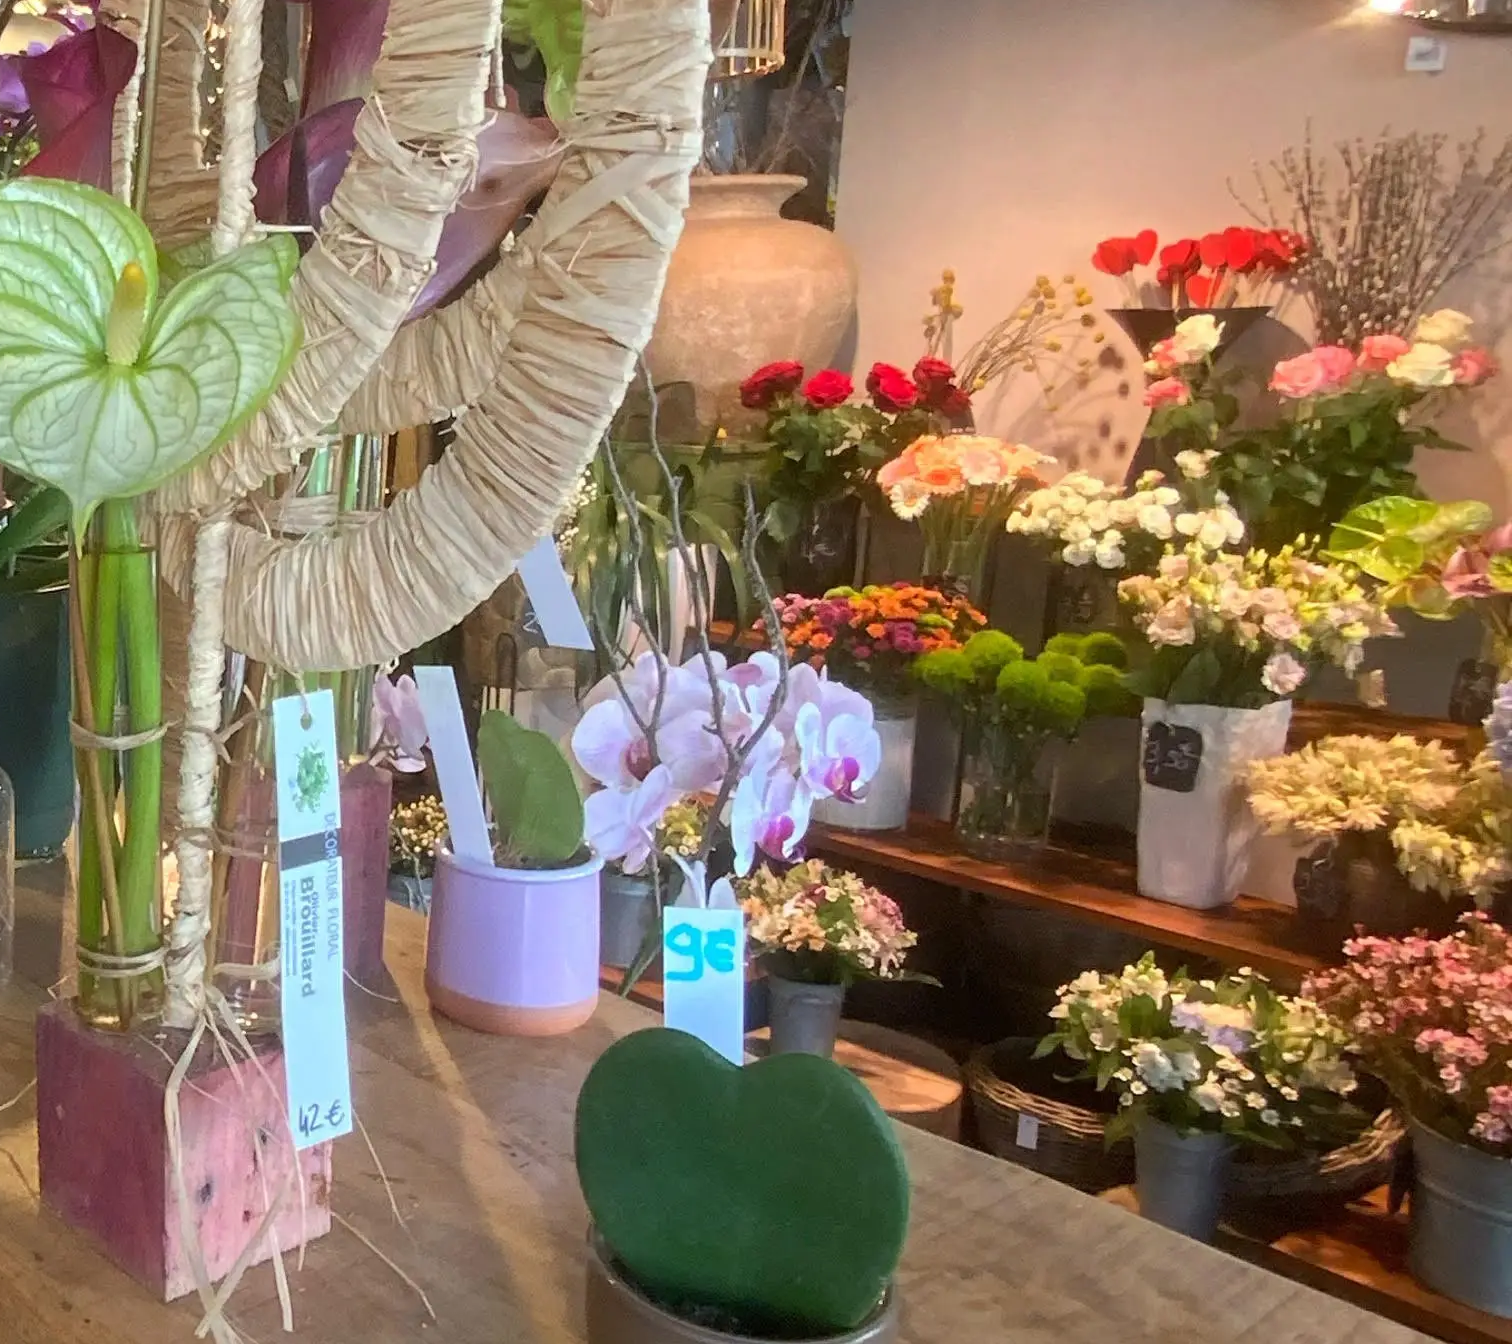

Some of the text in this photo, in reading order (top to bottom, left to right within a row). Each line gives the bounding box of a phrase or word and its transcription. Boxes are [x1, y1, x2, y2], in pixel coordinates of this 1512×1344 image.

[299, 876, 316, 998] Brouillard
[326, 907, 340, 962] FLORAL
[665, 923, 736, 981] 9€
